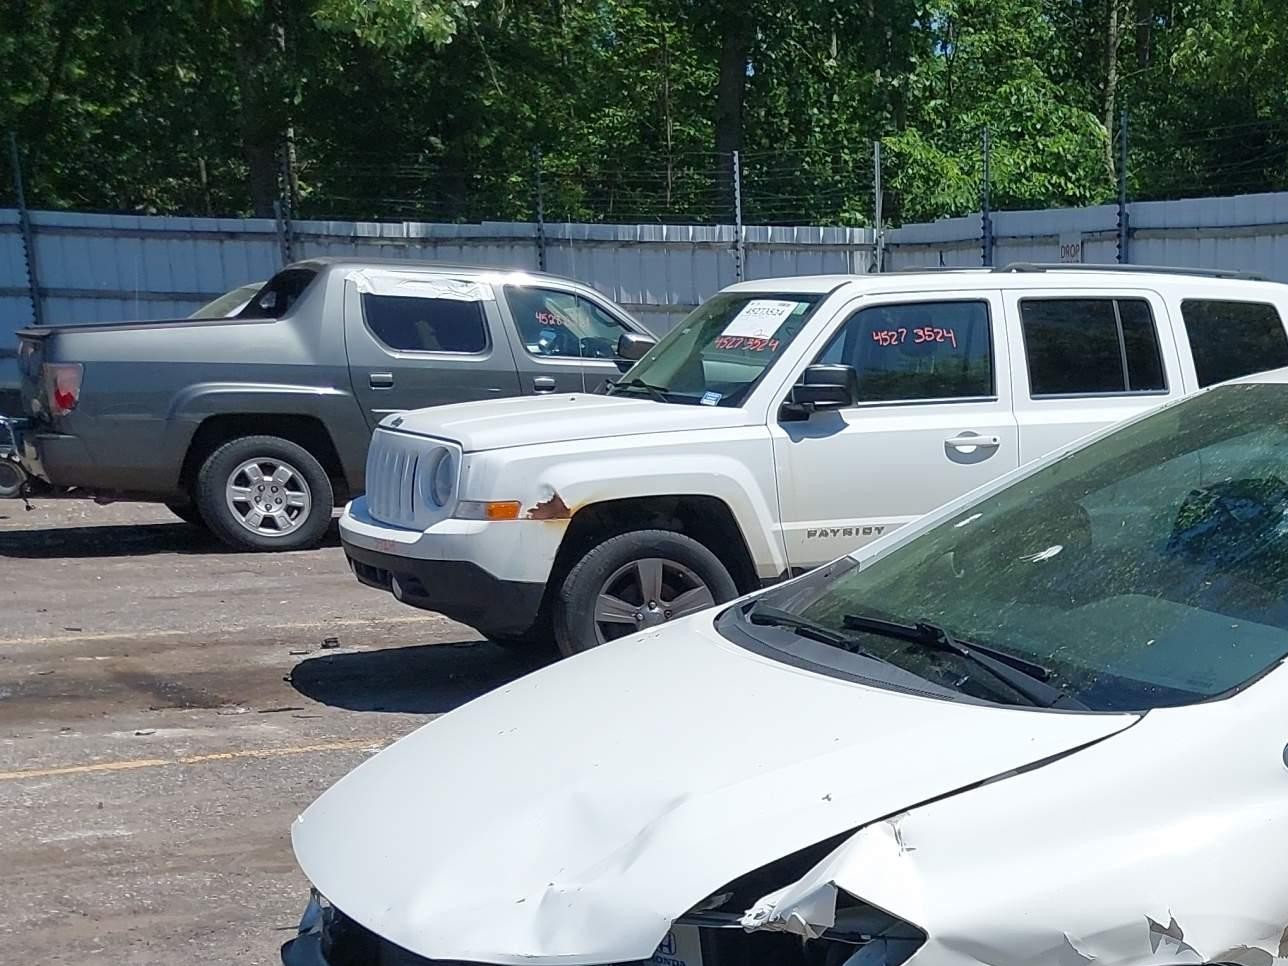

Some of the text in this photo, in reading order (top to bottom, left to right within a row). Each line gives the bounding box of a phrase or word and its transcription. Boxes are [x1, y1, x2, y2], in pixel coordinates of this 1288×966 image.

[872, 327, 957, 349] 4527 3524
[807, 526, 885, 539] PATRIOT
